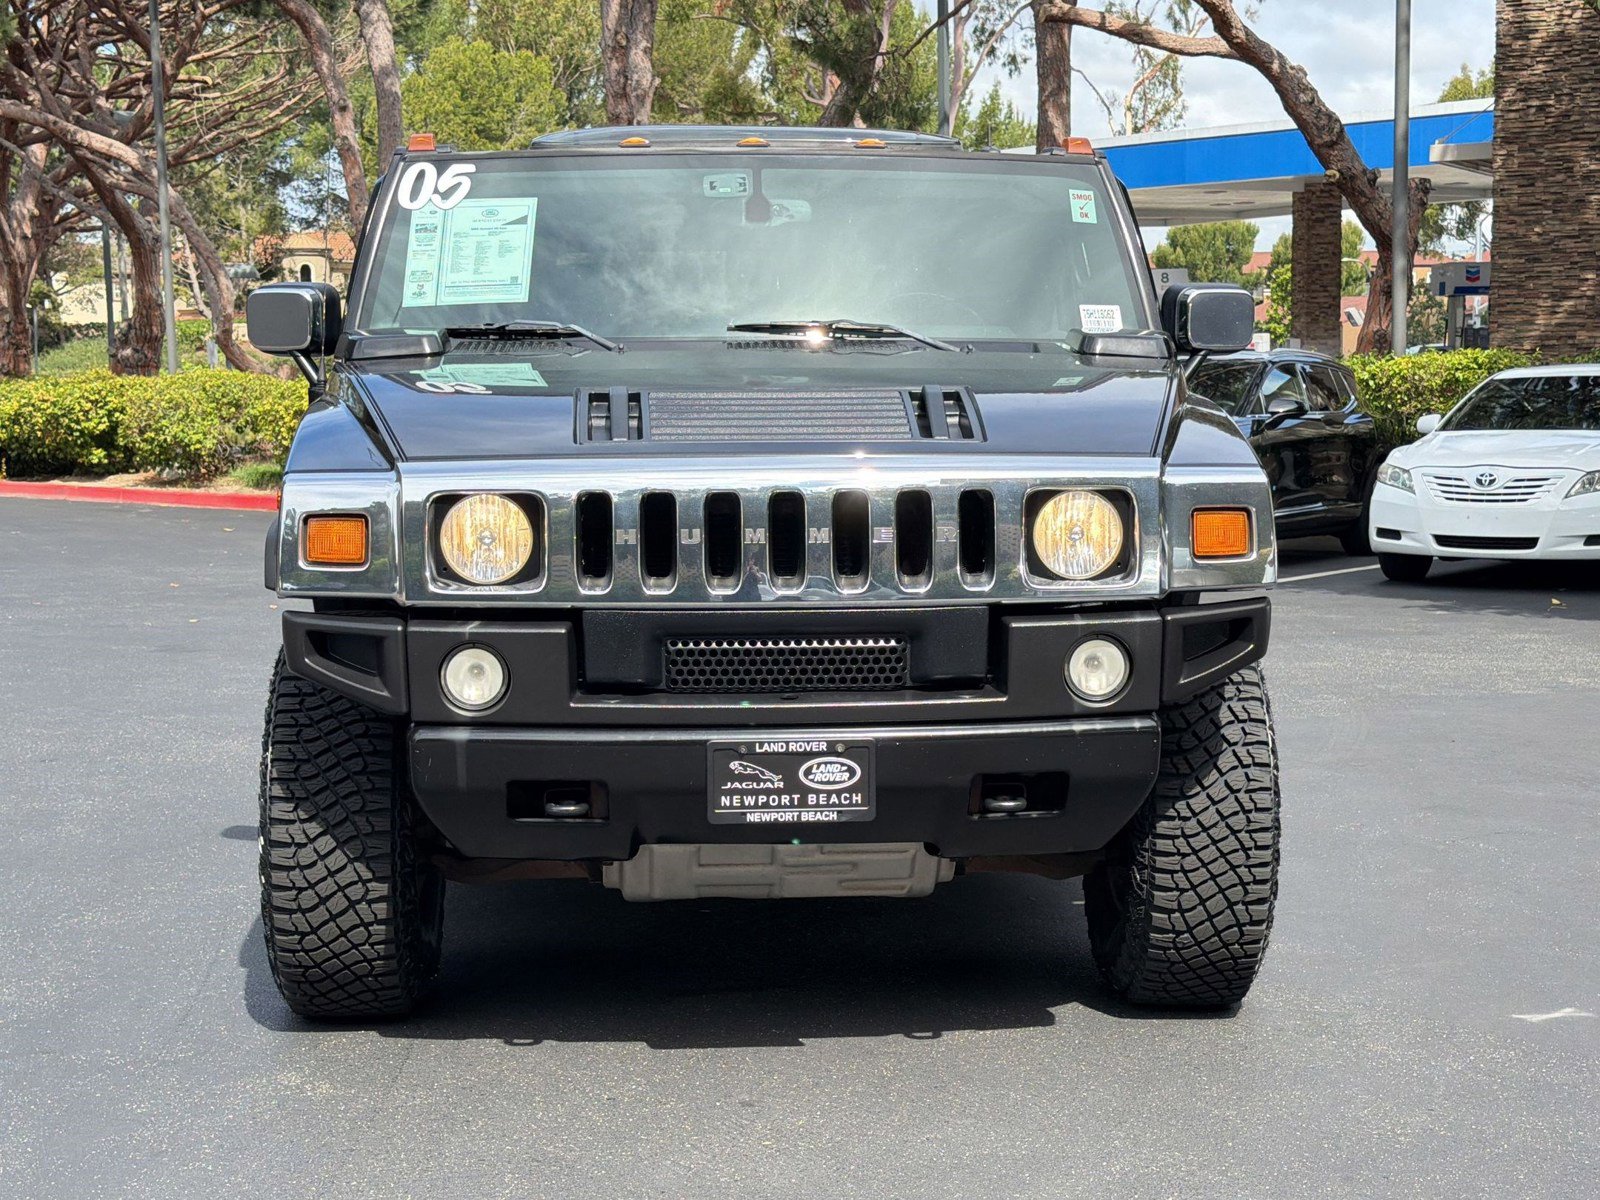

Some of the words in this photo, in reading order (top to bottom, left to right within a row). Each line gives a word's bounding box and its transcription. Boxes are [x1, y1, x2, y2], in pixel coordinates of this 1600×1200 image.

[397, 161, 477, 210] 05
[1071, 193, 1093, 201] SMOG
[1079, 211, 1090, 219] OK
[1160, 272, 1169, 283] 8
[615, 526, 957, 544] HUMMER
[755, 743, 787, 753] LAND
[788, 742, 827, 752] ROVER
[811, 763, 842, 773] LAND
[813, 772, 850, 782] ROVER
[721, 781, 784, 789] JAGUAR
[721, 794, 800, 807] NEWPORT
[808, 793, 862, 805] BEACH
[746, 812, 800, 822] NEWPORT
[801, 811, 837, 821] BEACH
